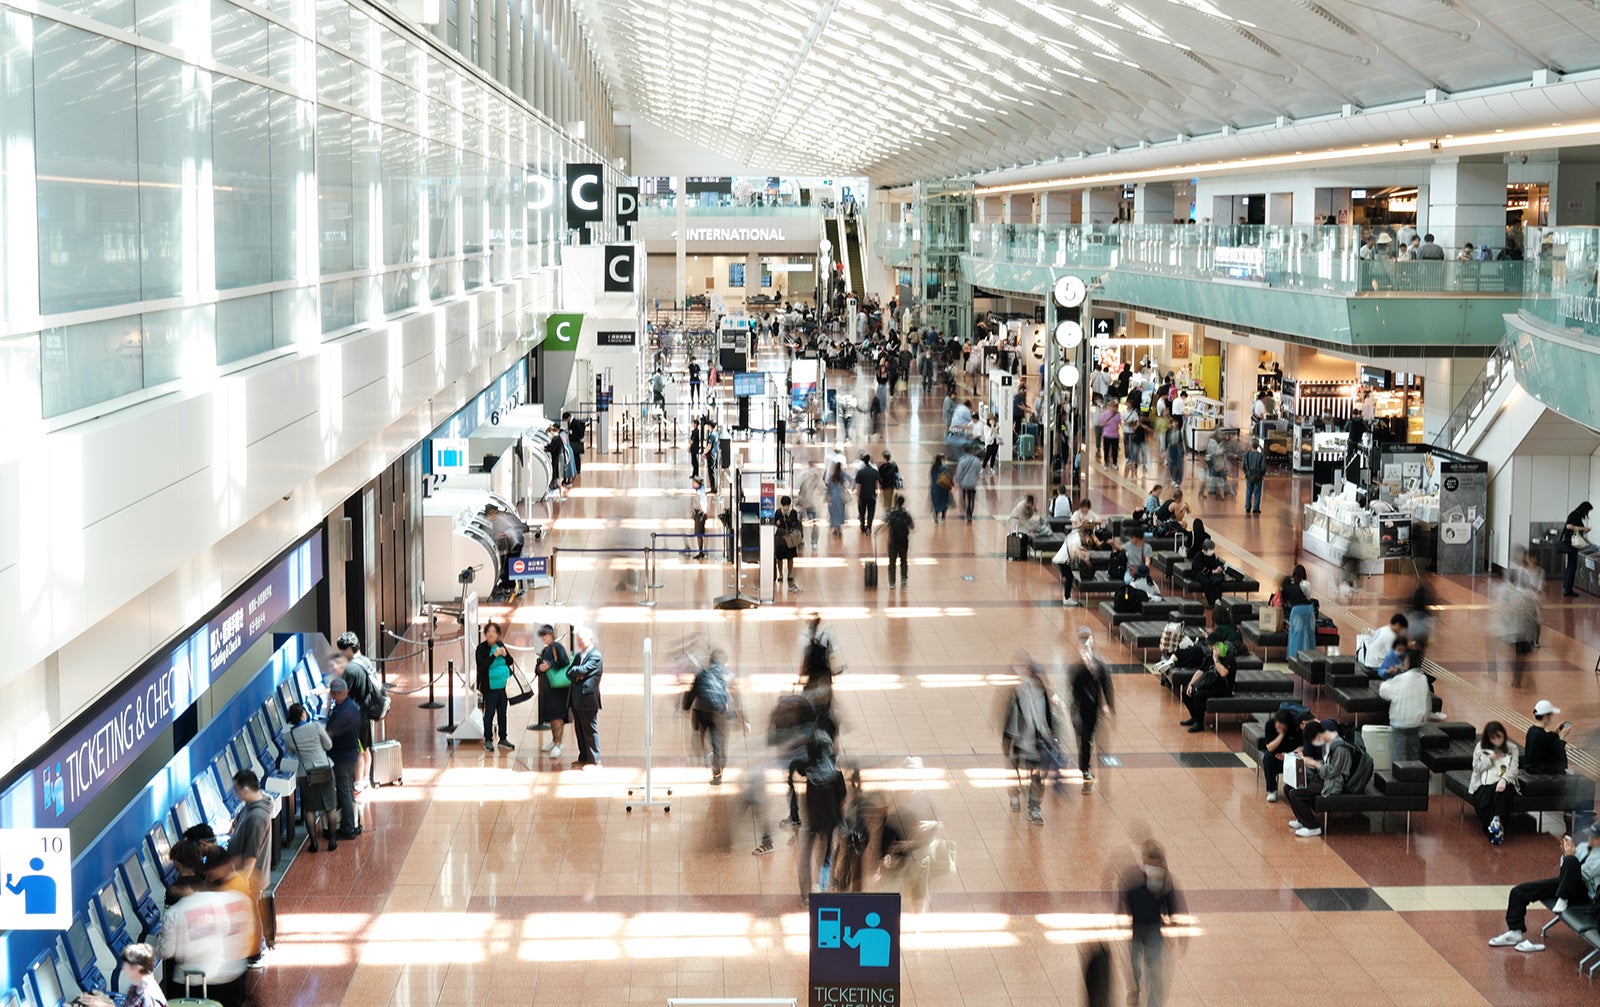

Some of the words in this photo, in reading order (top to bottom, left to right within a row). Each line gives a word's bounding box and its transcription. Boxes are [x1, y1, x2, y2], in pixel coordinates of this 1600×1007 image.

[571, 174, 598, 210] C
[618, 193, 636, 215] D
[686, 228, 785, 241] INTERNATIONAL
[608, 254, 630, 283] C
[1575, 295, 1593, 323] DECK
[556, 321, 571, 342] C
[490, 411, 500, 426] 6
[422, 477, 432, 499] 1
[66, 703, 134, 802] TICKETING
[135, 695, 146, 741] &
[40, 836, 63, 854] 10
[814, 986, 895, 1003] TICKETING
